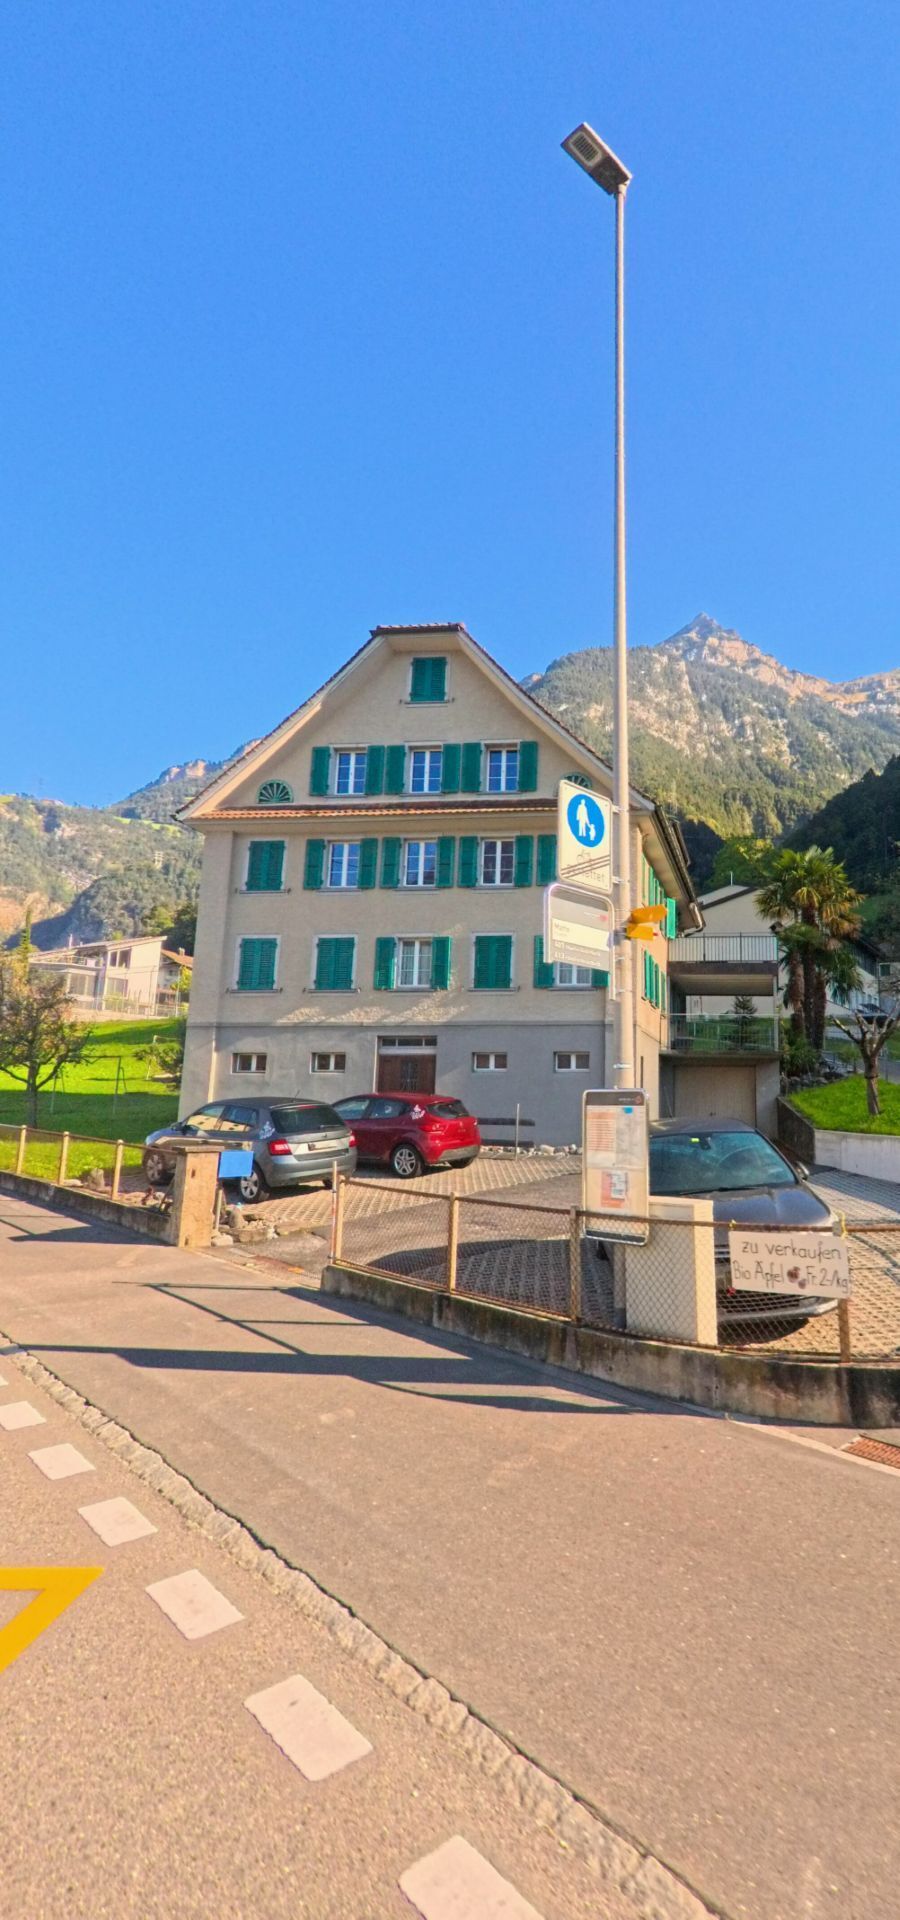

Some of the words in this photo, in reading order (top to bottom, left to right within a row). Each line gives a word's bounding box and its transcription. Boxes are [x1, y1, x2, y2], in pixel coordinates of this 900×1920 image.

[742, 1241, 759, 1254] zu
[765, 1238, 842, 1264] verkaufen
[732, 1259, 751, 1280] Bio
[754, 1260, 785, 1289] Äpfel
